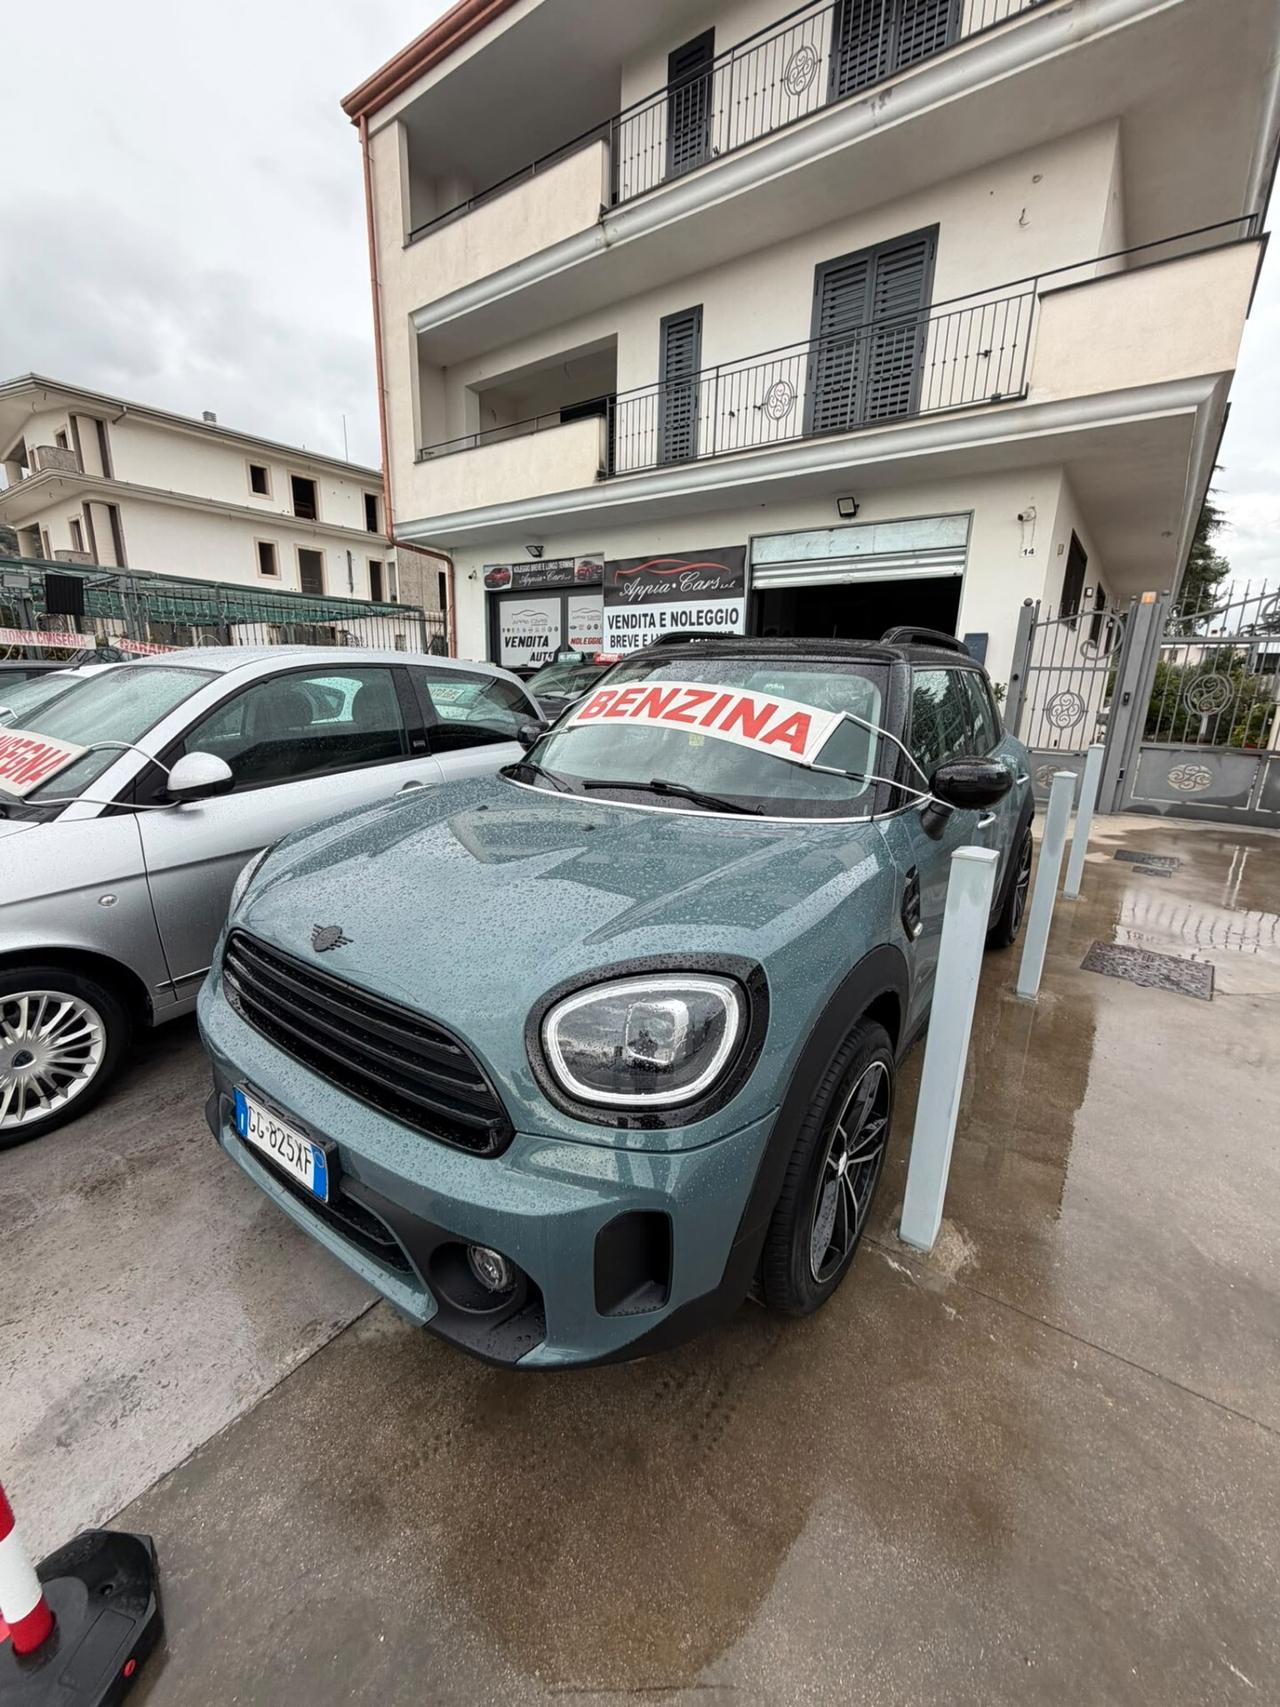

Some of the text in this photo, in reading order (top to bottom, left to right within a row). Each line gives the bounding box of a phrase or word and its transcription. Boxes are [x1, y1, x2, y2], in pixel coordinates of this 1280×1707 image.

[619, 577, 670, 601] Appia
[679, 571, 720, 592] Cars
[608, 608, 739, 630] VENDITA E NOLEGGIO
[505, 635, 549, 648] VENDITA
[610, 634, 639, 648] BREVE
[642, 633, 648, 647] E
[577, 686, 812, 755] BENZINA
